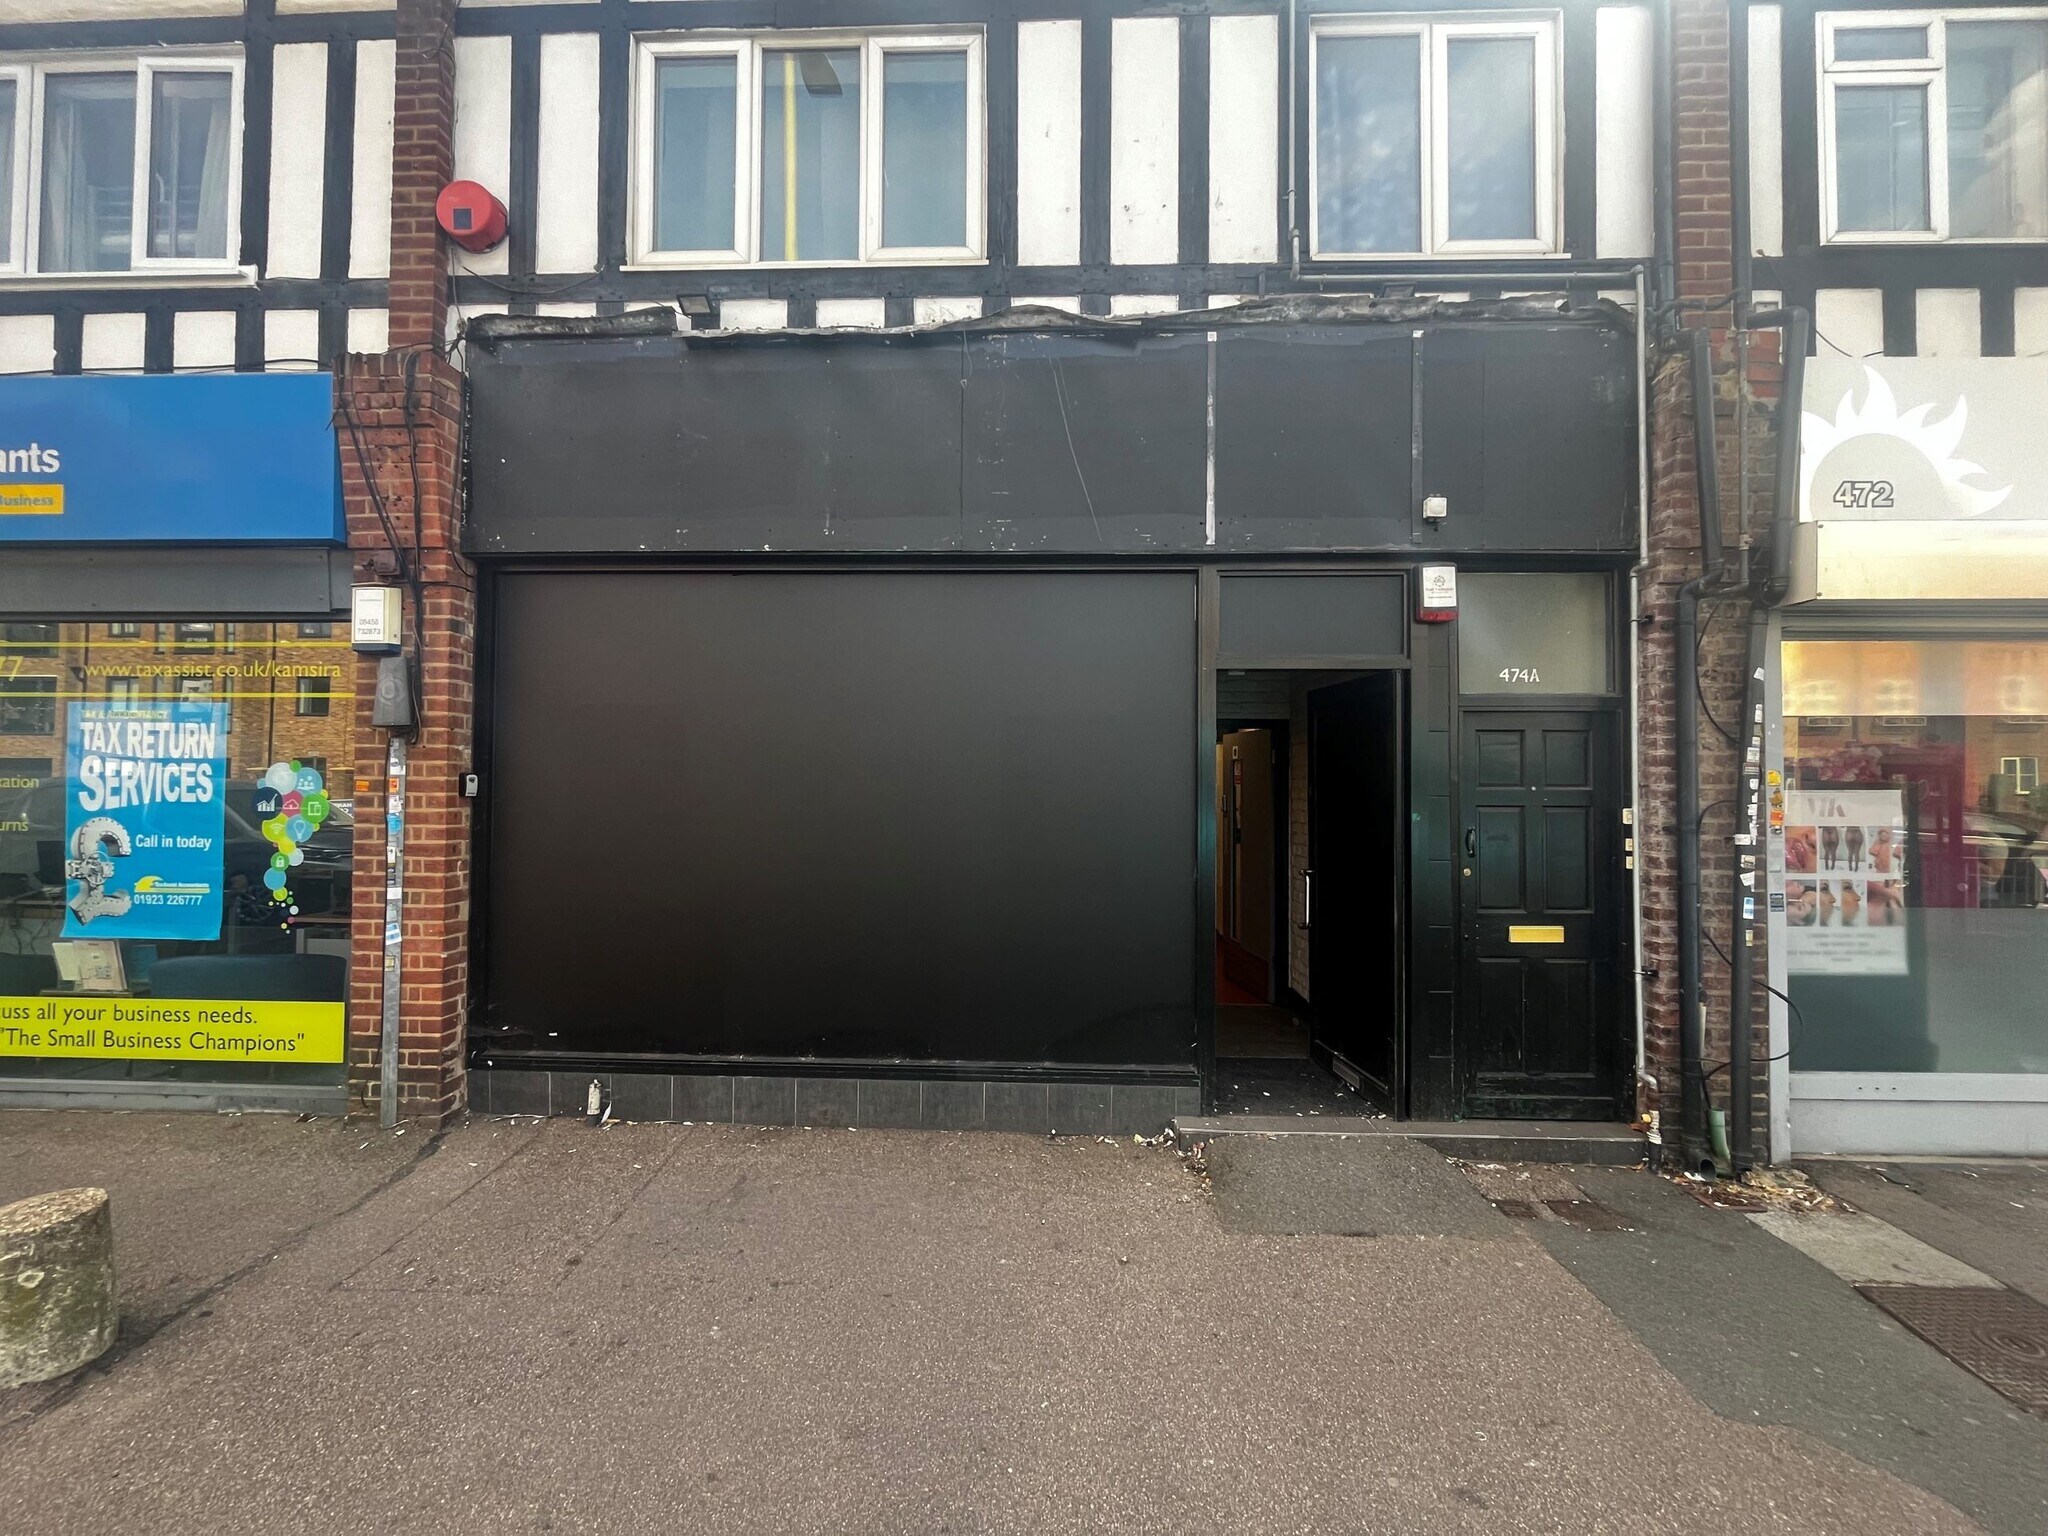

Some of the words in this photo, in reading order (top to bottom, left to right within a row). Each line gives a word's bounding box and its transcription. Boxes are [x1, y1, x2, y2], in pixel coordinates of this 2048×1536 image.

[1833, 480, 1894, 508] 472
[84, 659, 342, 678] www.taxassist.co.uk/kamsira
[1499, 668, 1540, 683] 474A
[80, 721, 122, 755] TAX
[127, 721, 216, 759] RETURN
[0, 774, 40, 788] ation
[78, 754, 214, 812] SERVICES
[135, 834, 158, 848] Call
[161, 834, 173, 848] in
[176, 835, 212, 851] today
[133, 894, 164, 905] 01923
[166, 894, 203, 906] 226777
[0, 1007, 30, 1020] uss
[36, 1002, 56, 1020] all
[63, 1008, 106, 1026] your
[113, 1003, 190, 1022] business
[198, 1006, 258, 1024] needs.
[48, 1028, 95, 1047] Small
[103, 1030, 181, 1049] Business
[189, 1031, 305, 1056] Champions"
